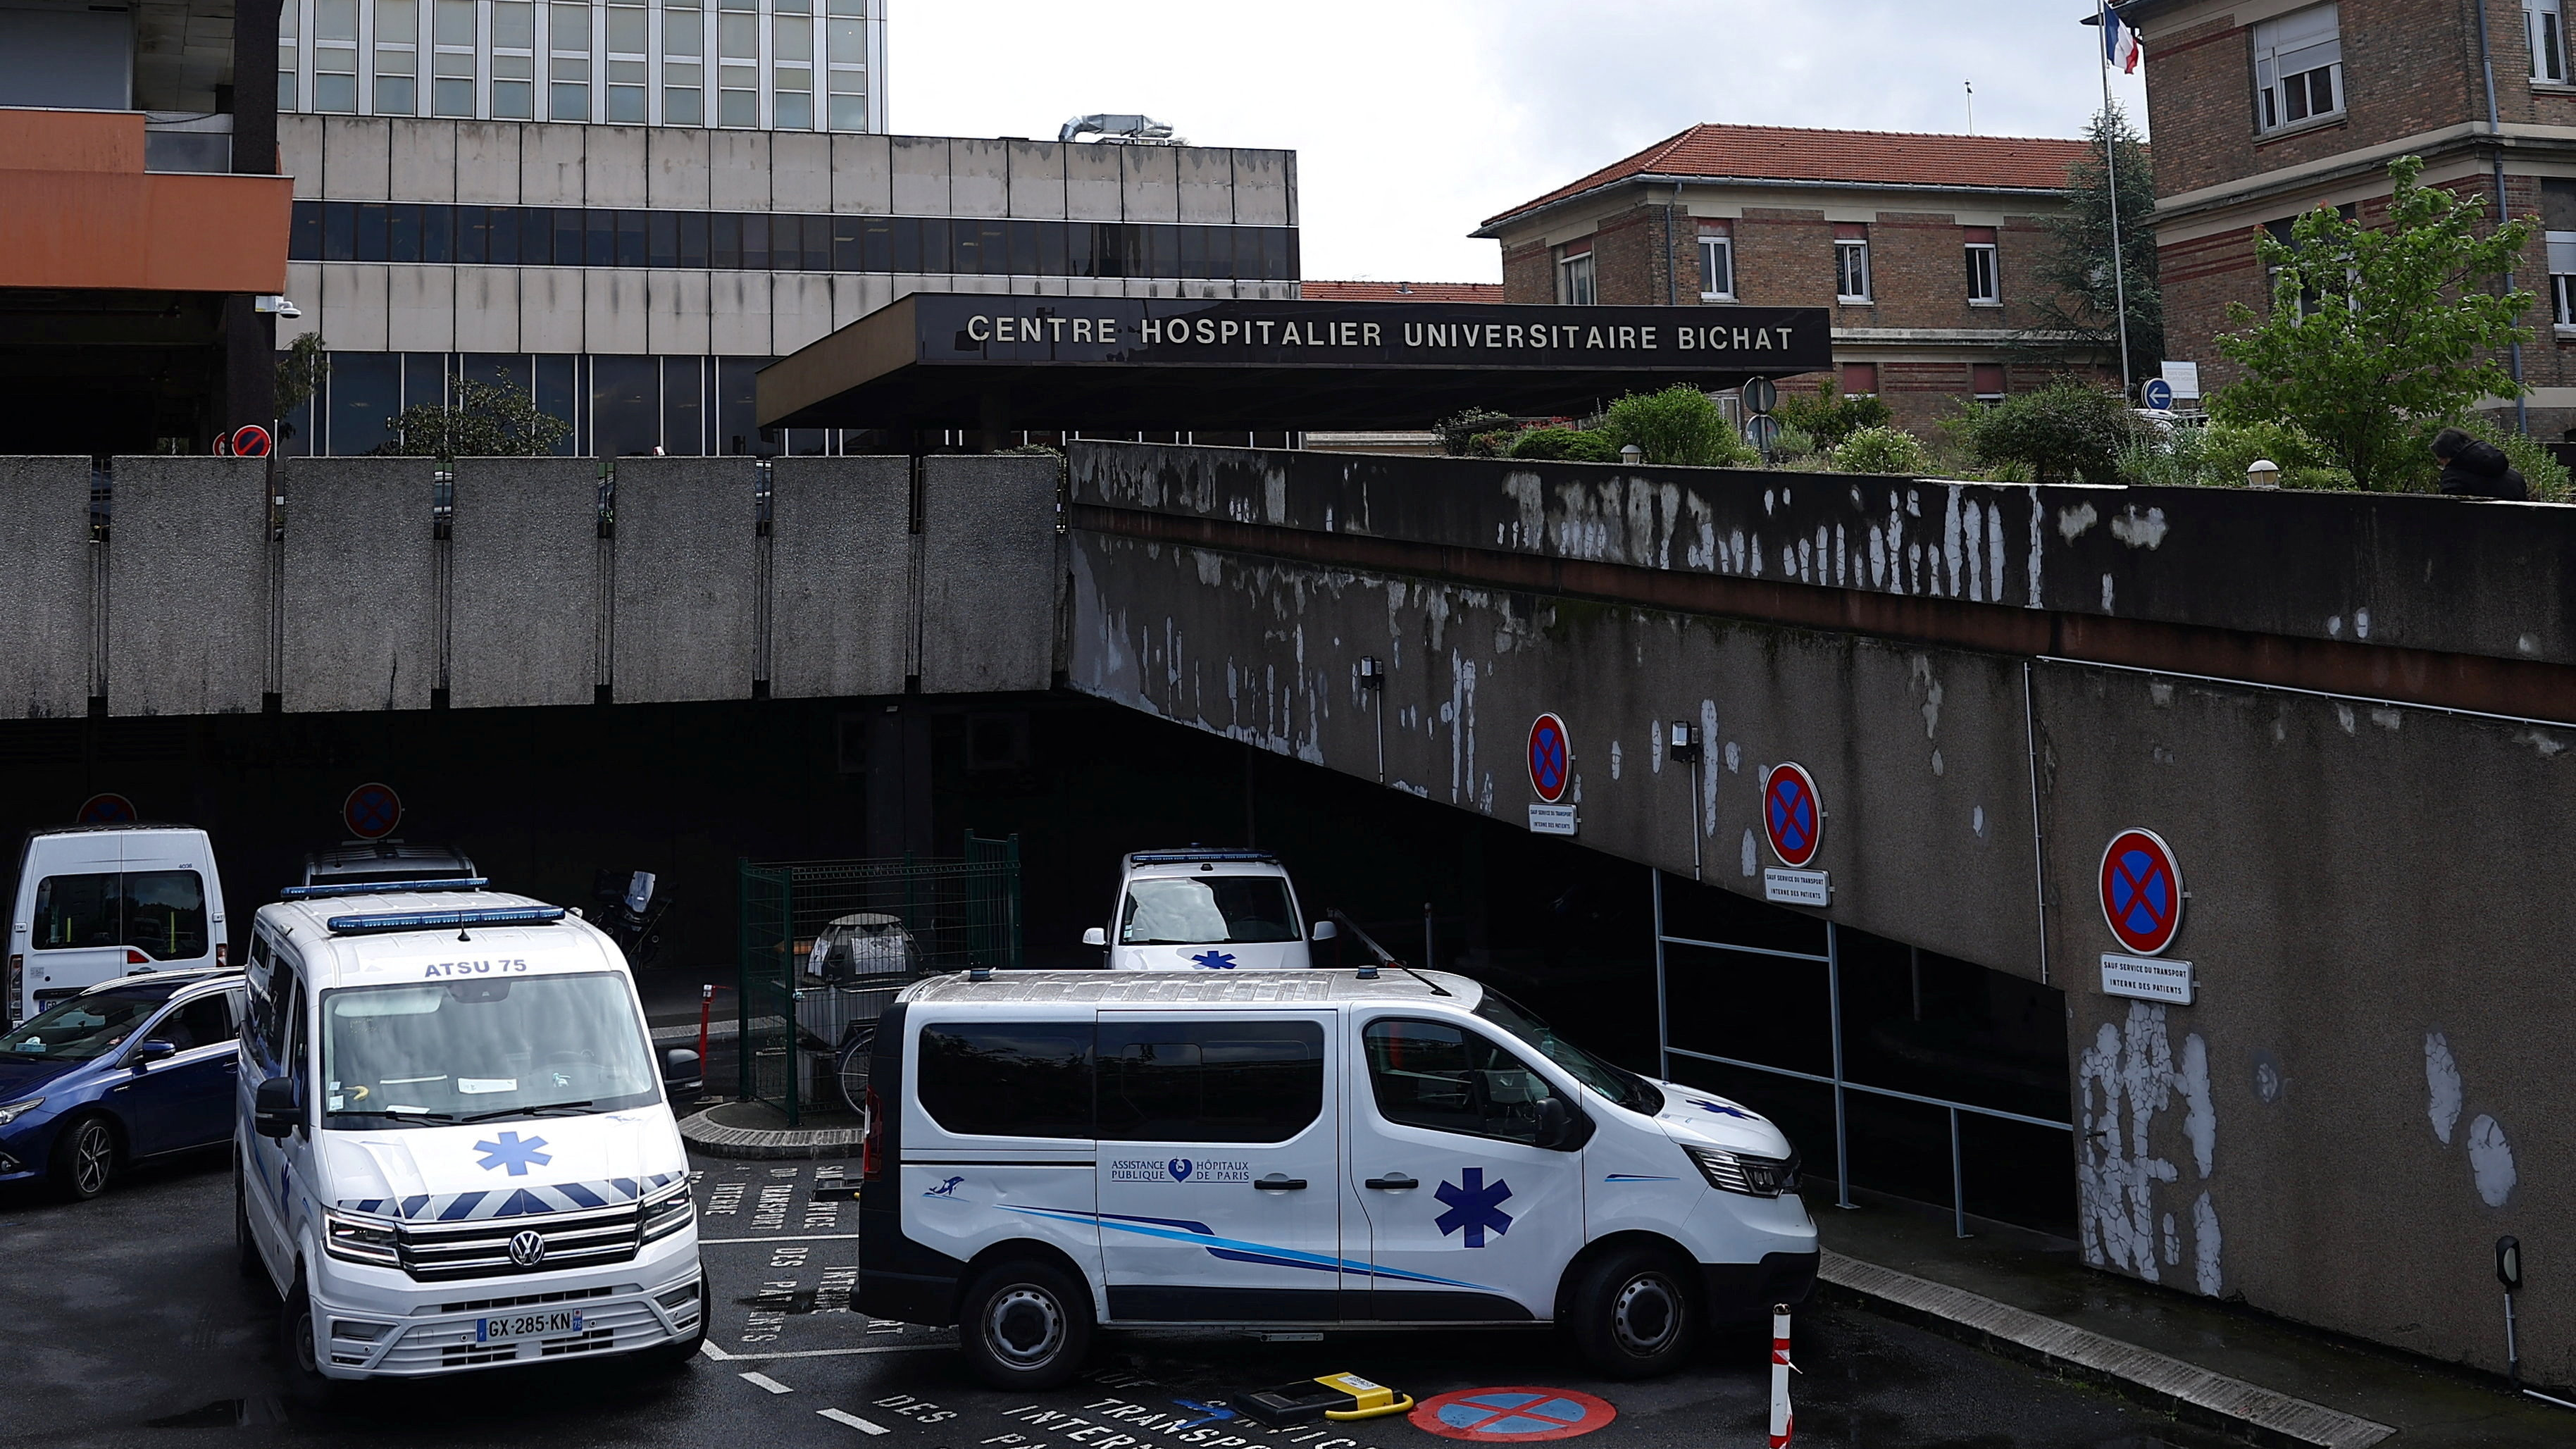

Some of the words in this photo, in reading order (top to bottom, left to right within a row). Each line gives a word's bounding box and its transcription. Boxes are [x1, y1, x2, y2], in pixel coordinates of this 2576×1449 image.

[967, 315, 1116, 343] CENTRE
[1140, 318, 1381, 347] HOSPITALIER
[1404, 322, 1657, 350] UNIVERSITAIRE
[1678, 326, 1793, 351] BICHAT
[425, 961, 490, 978] ATSU
[498, 959, 527, 972] 75
[2120, 963, 2143, 973] SERVICE
[2153, 967, 2186, 978] TRANSPORT
[2110, 978, 2136, 989] INTERNE
[2153, 985, 2182, 995] PATIENTS
[1112, 1160, 1165, 1169] ASSISTANCE
[1196, 1159, 1249, 1170] HÔPITAUX
[1112, 1171, 1165, 1181] PUBLIQUE
[1197, 1171, 1209, 1180] DE
[1217, 1171, 1250, 1181] PARIS
[704, 1183, 747, 1216] INTERNE
[749, 1184, 794, 1230] TRANSPORT
[770, 1247, 809, 1267] DES
[489, 1312, 571, 1338] GX-285-KN
[573, 1319, 582, 1329] 75
[872, 1395, 958, 1423] DES
